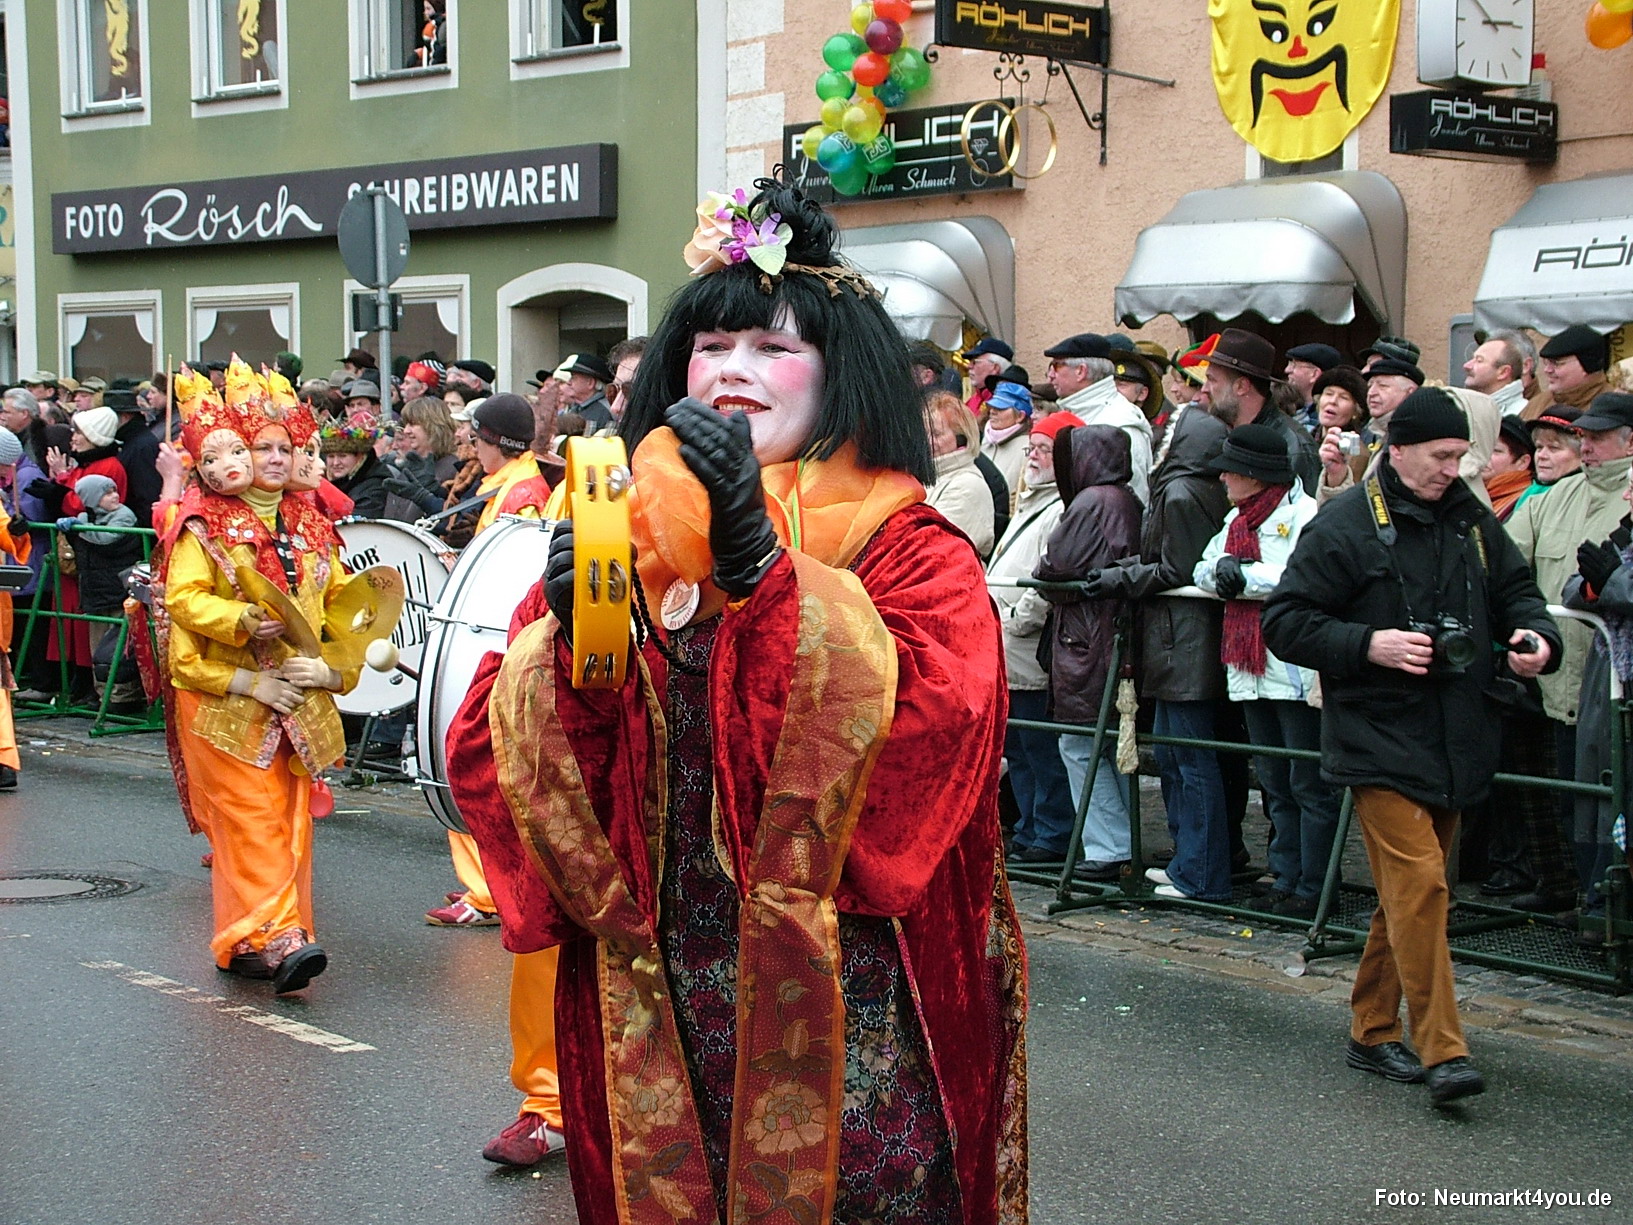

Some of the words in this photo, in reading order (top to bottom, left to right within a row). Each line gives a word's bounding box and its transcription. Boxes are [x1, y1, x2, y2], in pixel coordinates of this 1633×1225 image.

[957, 1, 1090, 38] RÖHLICH
[1430, 96, 1554, 126] RÖHLICH
[902, 166, 956, 190] Schmuck
[65, 203, 124, 240] FOTO
[141, 185, 323, 245] Rösch
[347, 162, 579, 215] HREIBWAREN
[1533, 235, 1633, 272] RÖ
